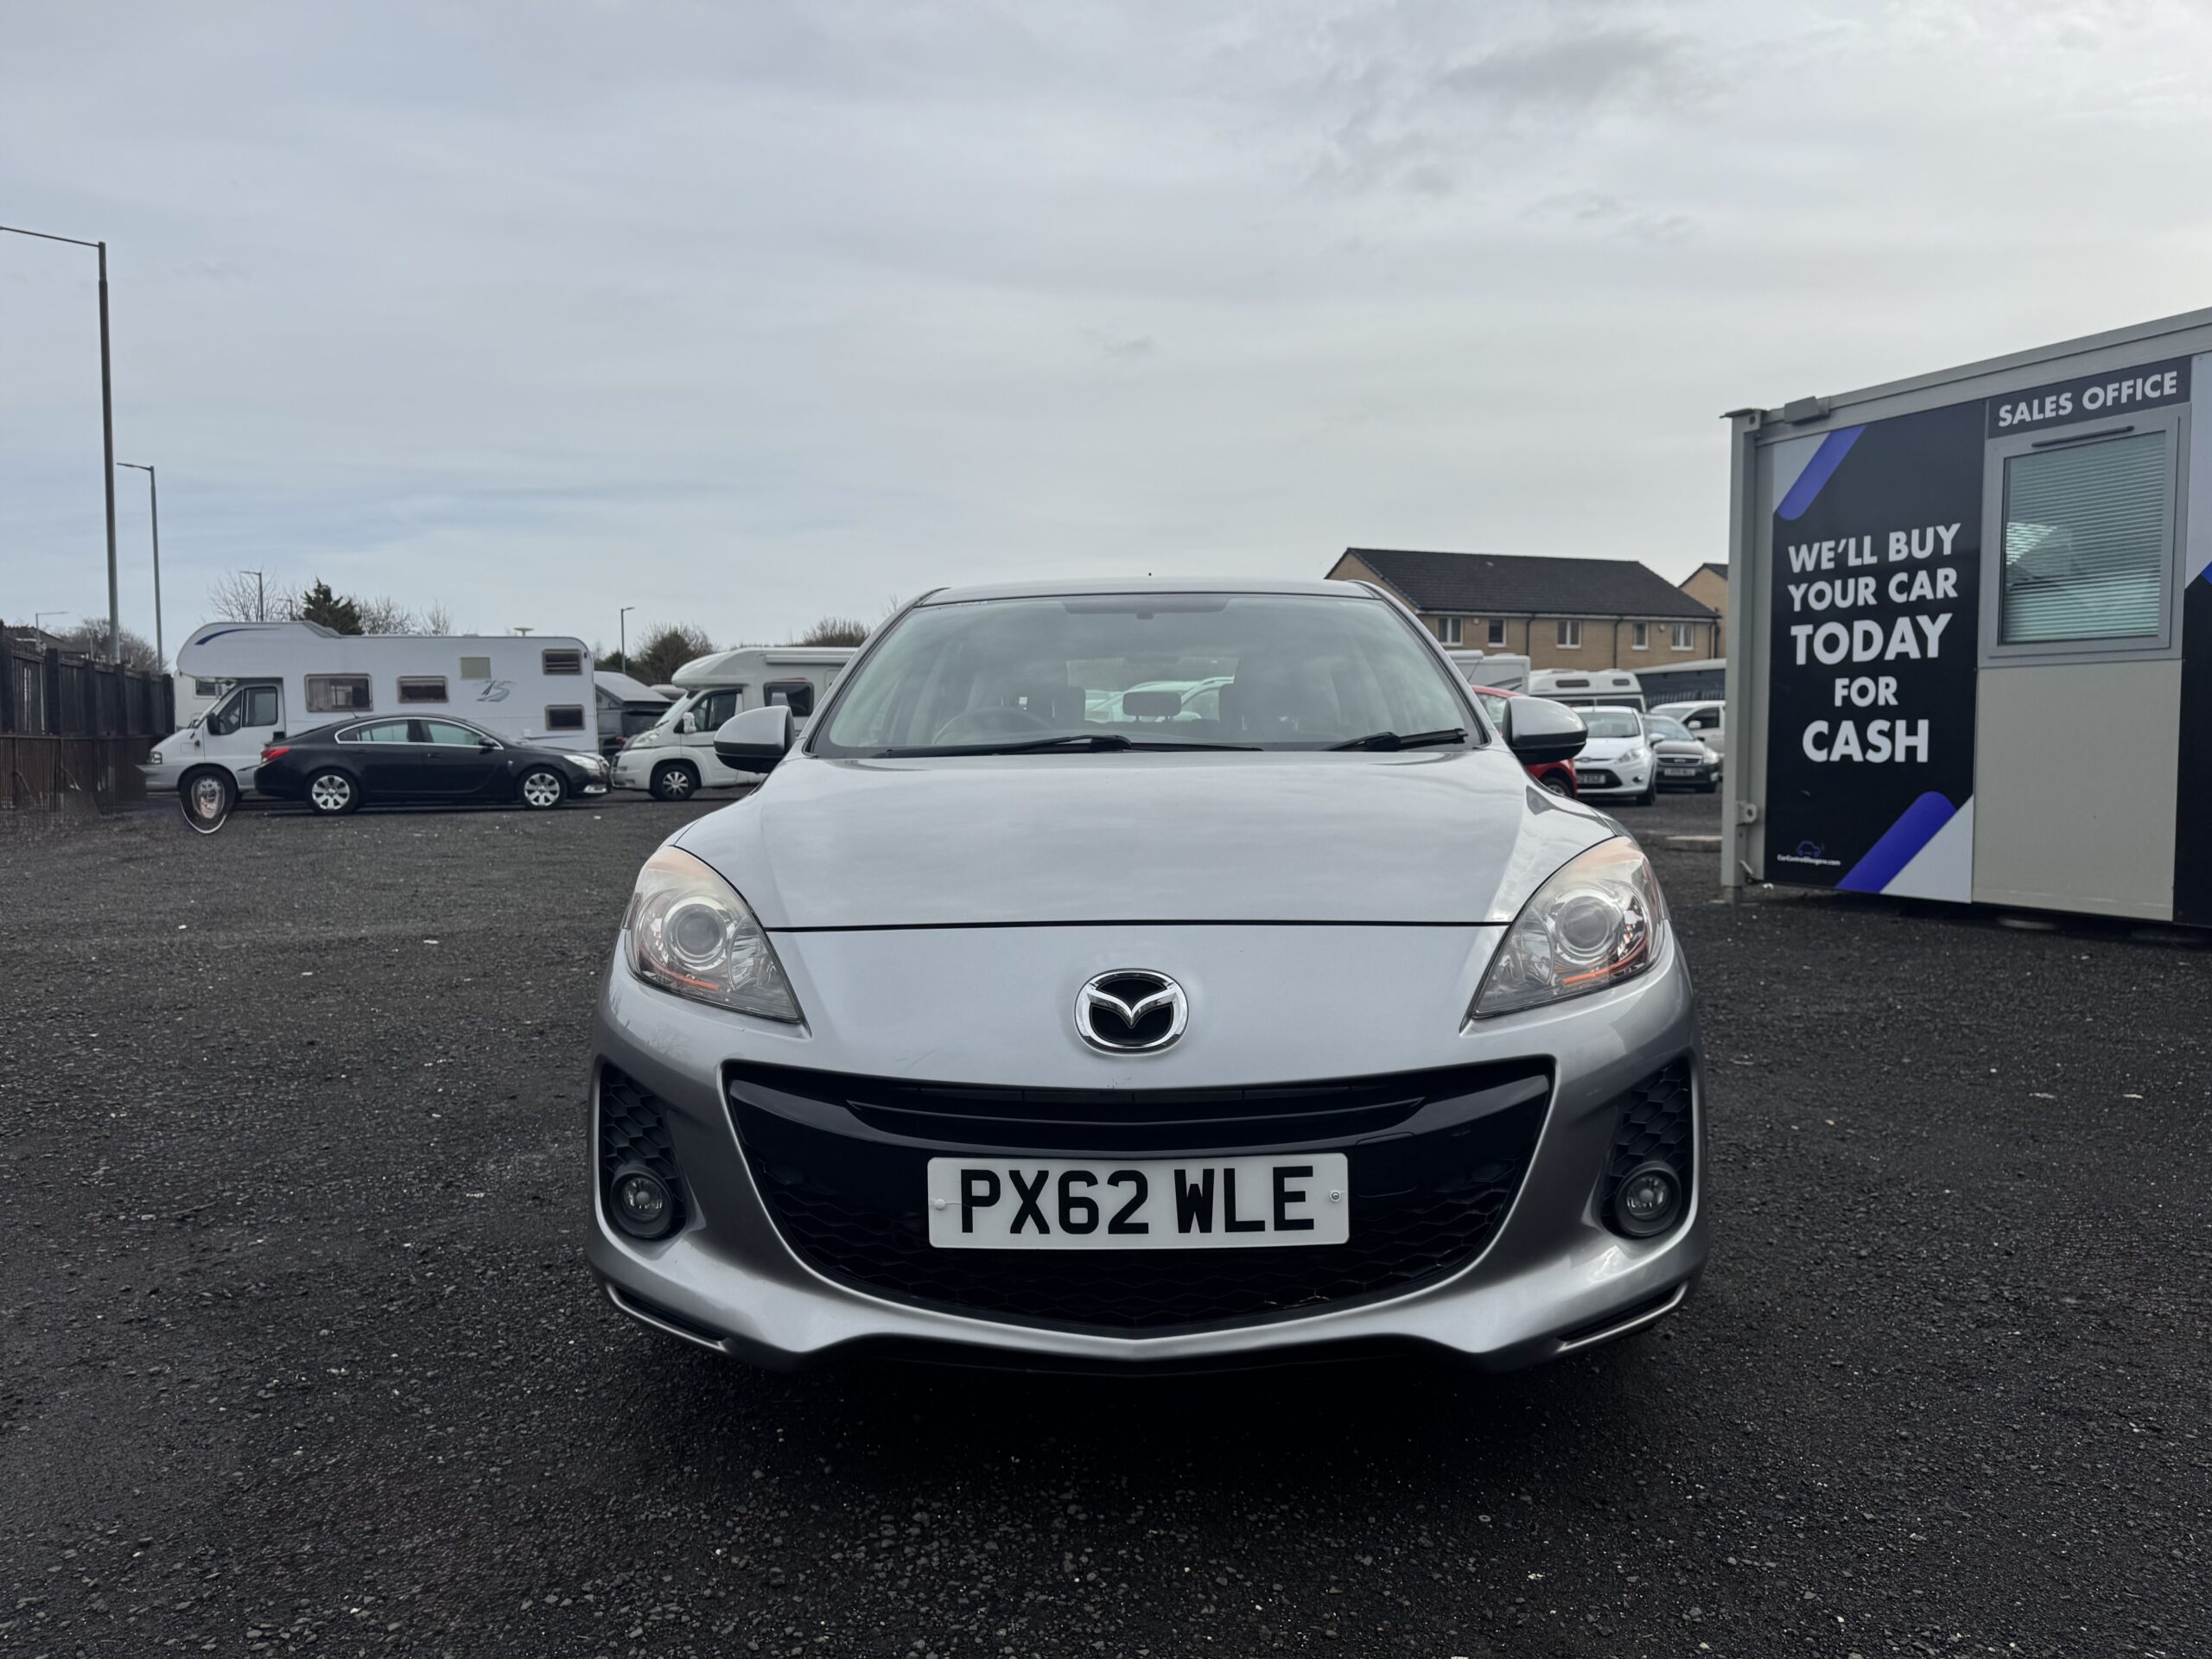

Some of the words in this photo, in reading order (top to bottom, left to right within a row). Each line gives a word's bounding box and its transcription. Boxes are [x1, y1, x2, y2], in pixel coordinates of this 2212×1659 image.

[1999, 392, 2073, 427] SALES
[2082, 371, 2177, 410] OFFICE
[1788, 535, 1878, 573] WE'LL
[1889, 523, 1961, 562] BUY
[1788, 576, 1878, 612] YOUR
[1888, 568, 1958, 603] CAR
[1790, 613, 1953, 665] TODAY
[1834, 676, 1898, 707] FOR
[1802, 719, 1929, 763] CASH
[961, 1169, 1149, 1235] PX62
[1174, 1166, 1315, 1234] WLE
